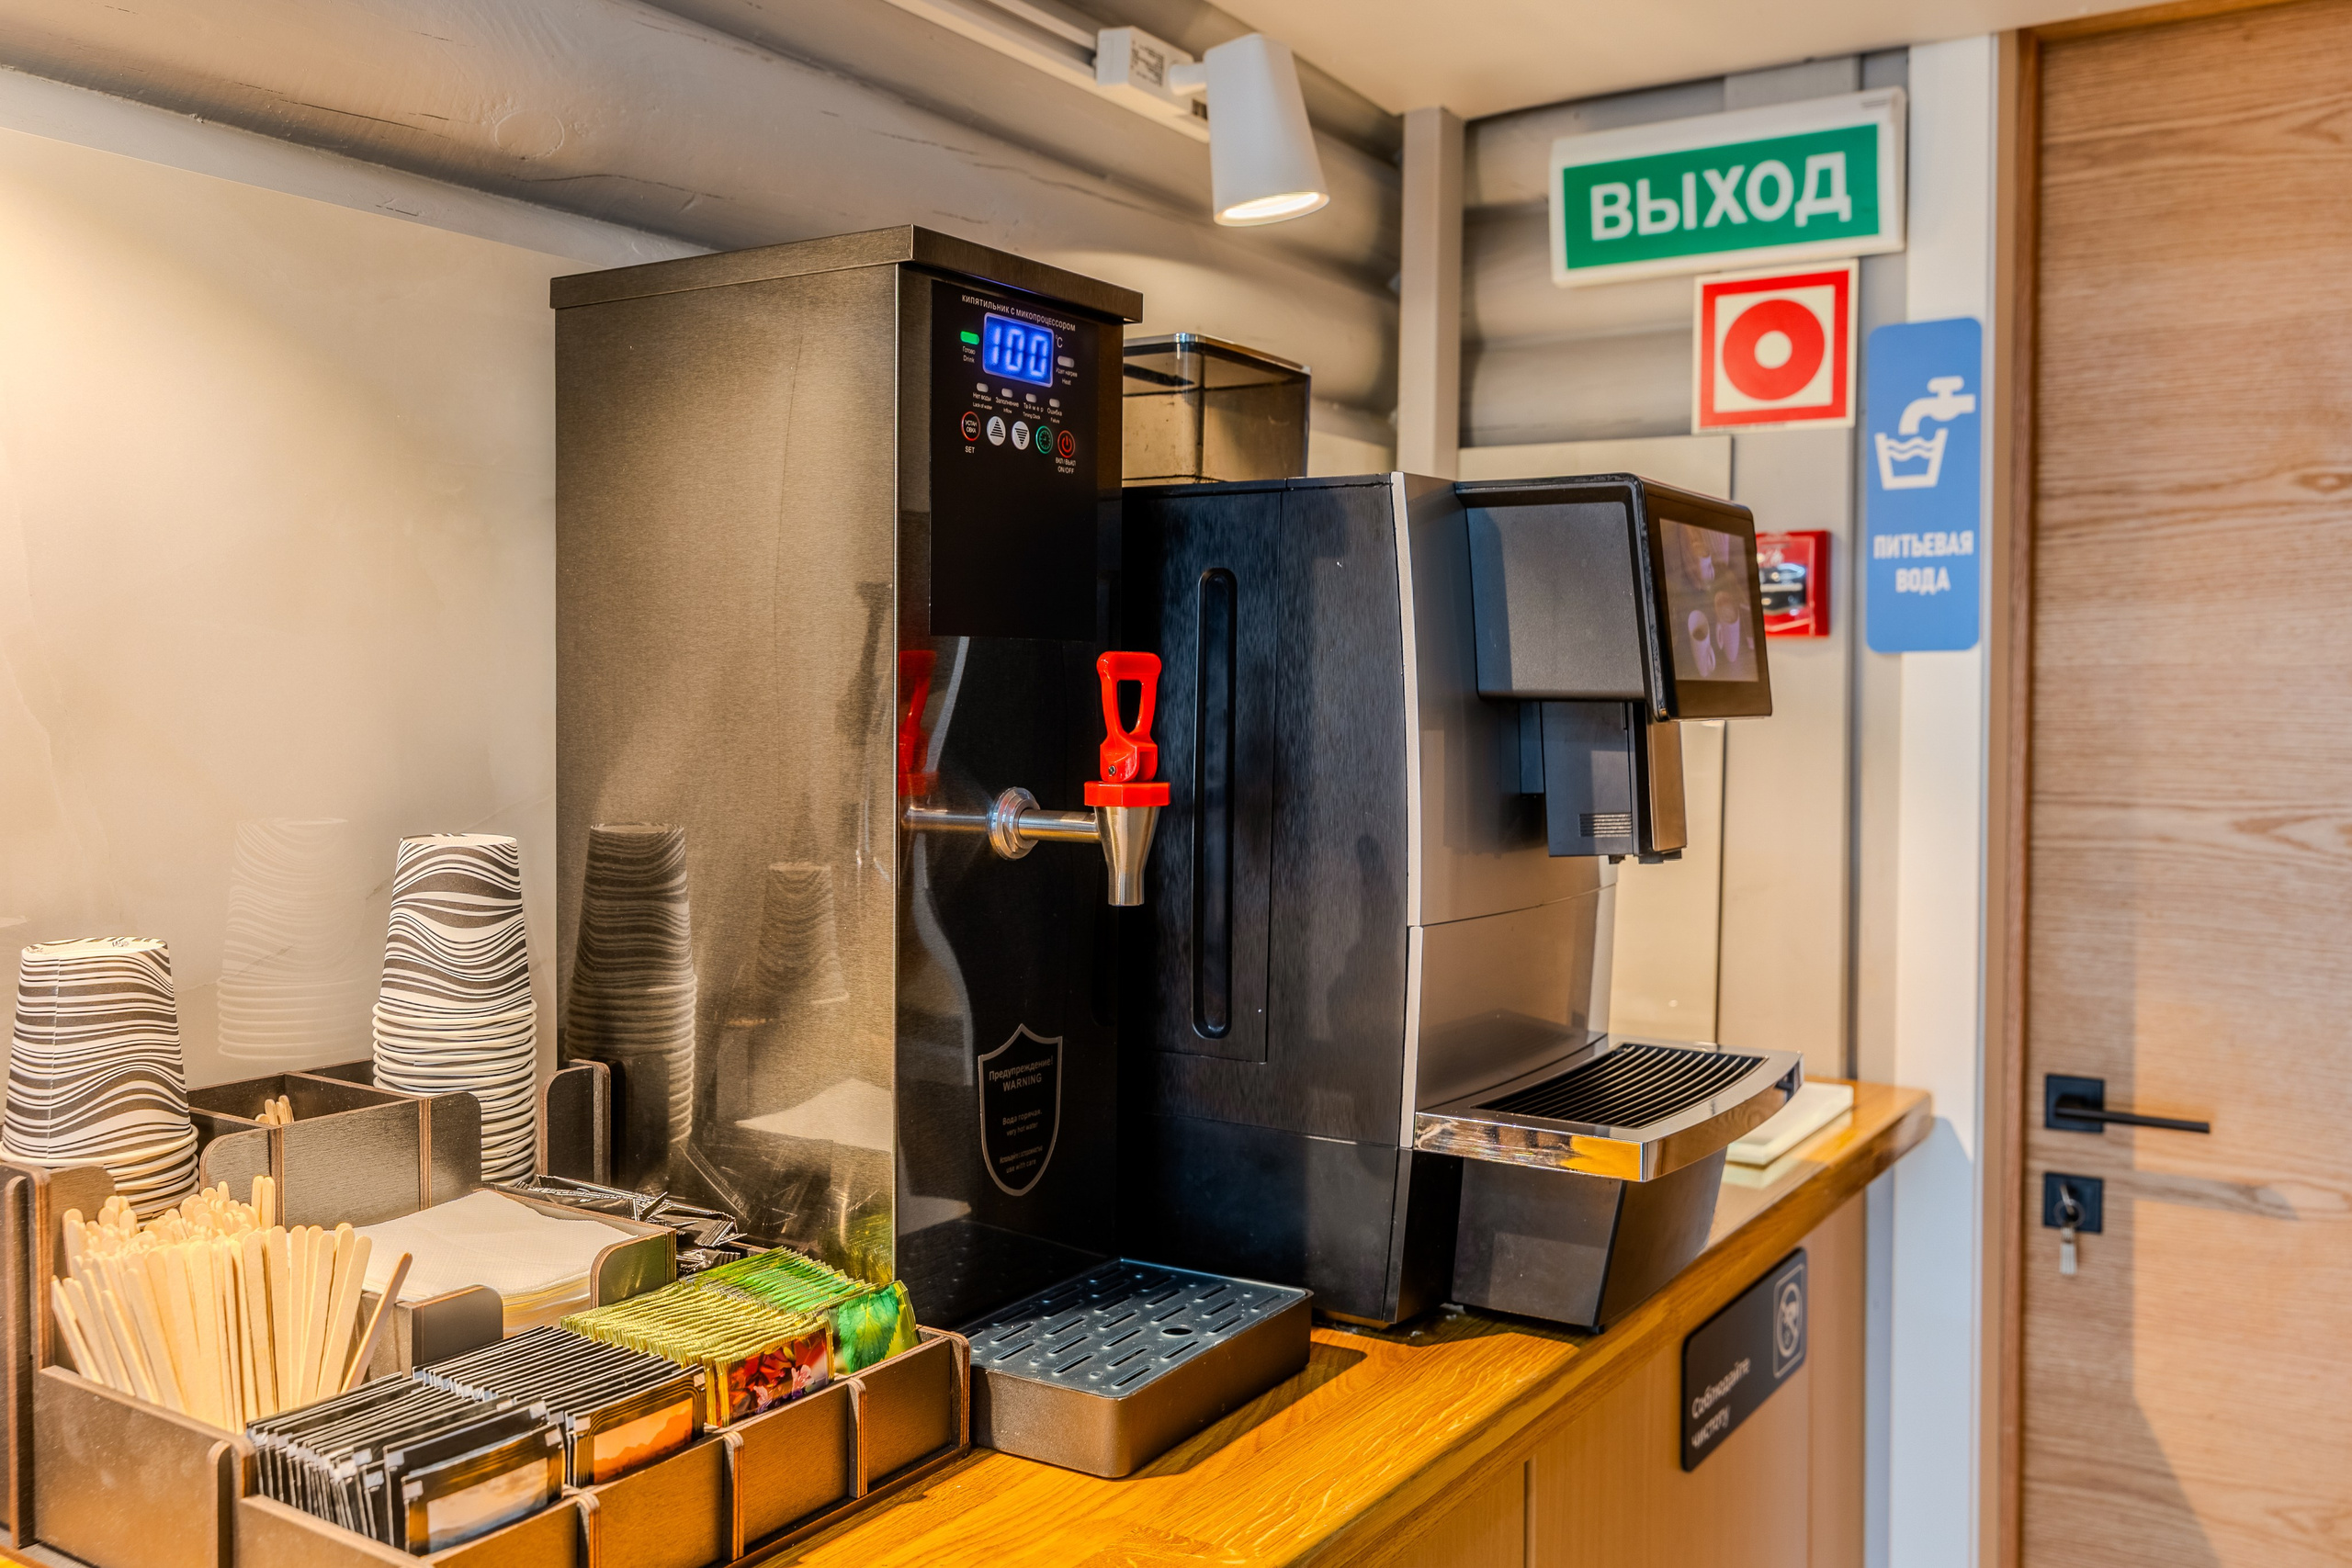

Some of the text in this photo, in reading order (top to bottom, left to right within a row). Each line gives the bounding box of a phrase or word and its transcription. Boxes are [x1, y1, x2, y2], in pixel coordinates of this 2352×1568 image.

[1590, 151, 1852, 242] ВЫХОД
[963, 355, 975, 364] Drink
[992, 327, 1048, 378] 100
[1061, 378, 1071, 386] Heat
[965, 446, 975, 454] SET
[1057, 466, 1075, 475] ON/OFF
[1873, 530, 1974, 559] ПИТЬЕВАЯ
[1895, 566, 1951, 596] ВОДА
[989, 1055, 1054, 1082] Предупреждение!
[1002, 1073, 1043, 1092] WARNING
[1002, 1114, 1018, 1126] Вода
[1691, 1358, 1751, 1420] Соблюдайте
[1690, 1404, 1731, 1450] чистоту
